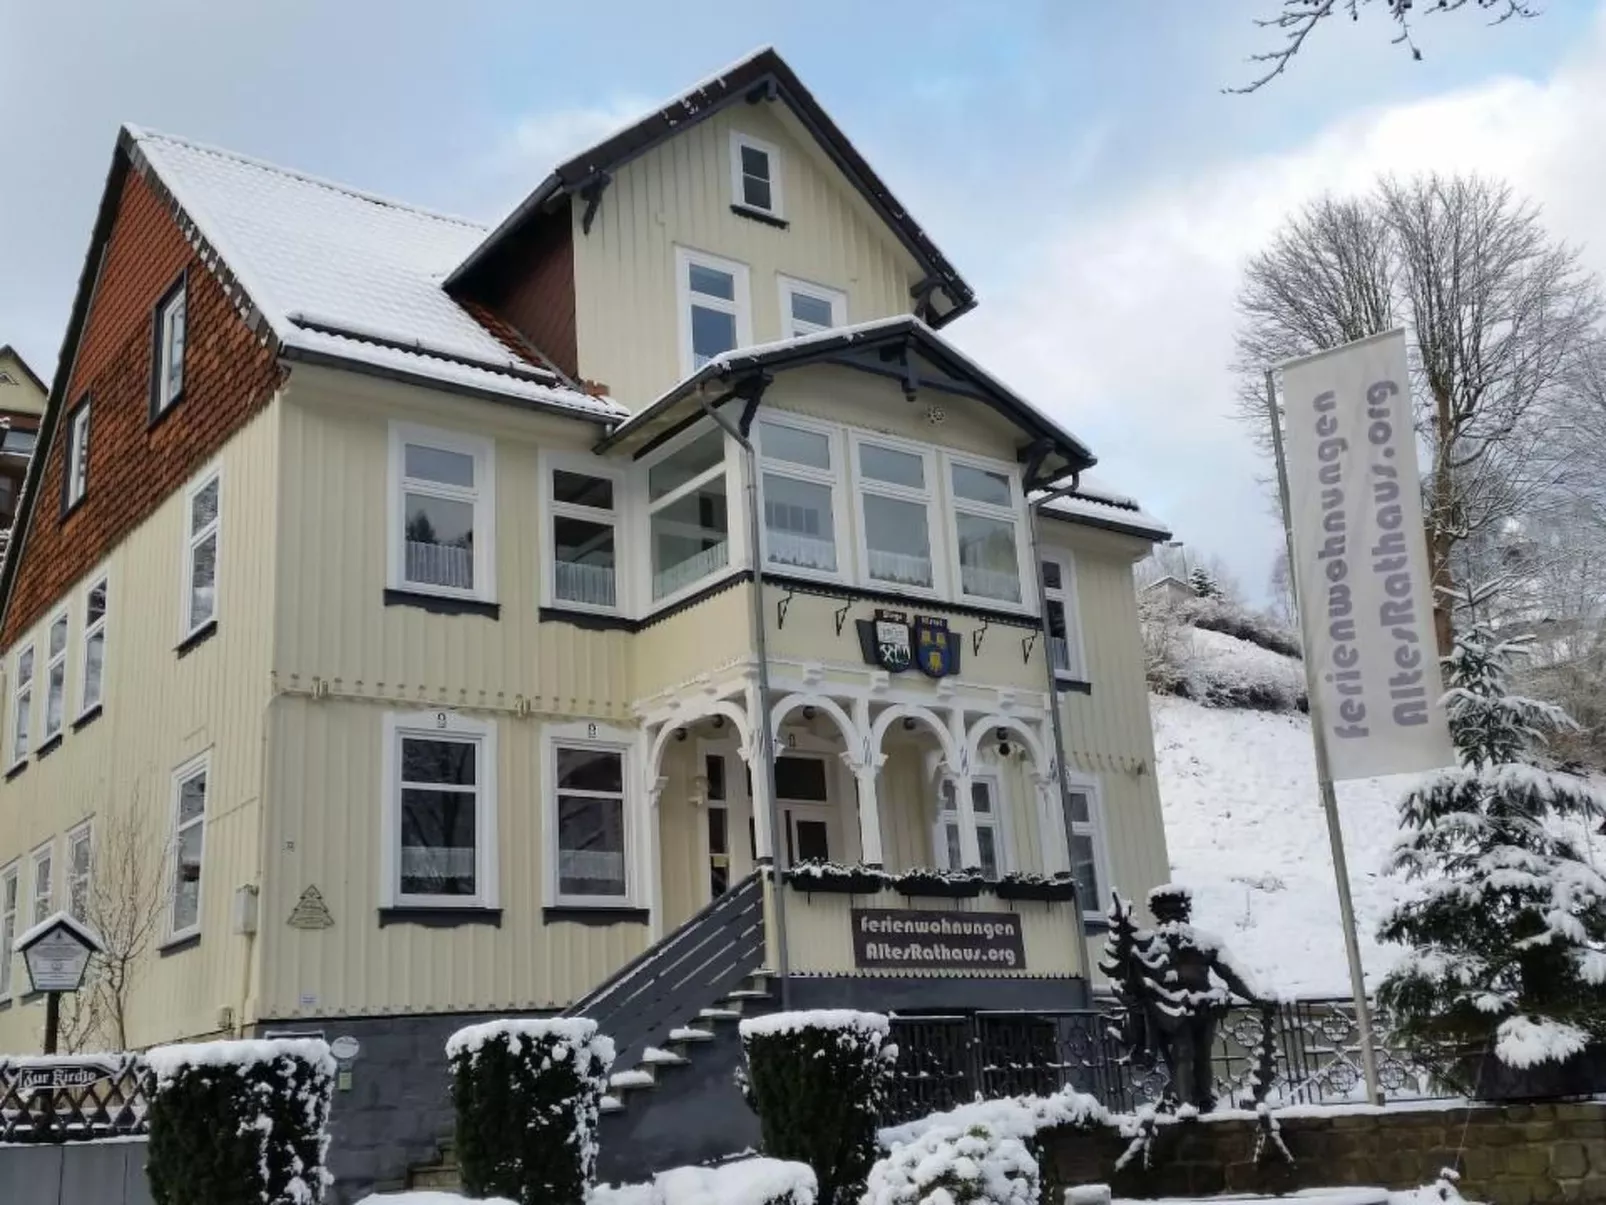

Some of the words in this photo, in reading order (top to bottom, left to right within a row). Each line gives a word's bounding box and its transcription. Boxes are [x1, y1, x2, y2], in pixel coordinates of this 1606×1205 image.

[1313, 389, 1369, 739] ferienwohnungen
[1366, 380, 1428, 727] AltesRathaus.org
[860, 915, 1015, 940] ferienwohnungen
[866, 942, 1016, 966] AltesRathaus.org
[24, 1070, 50, 1087] Zur
